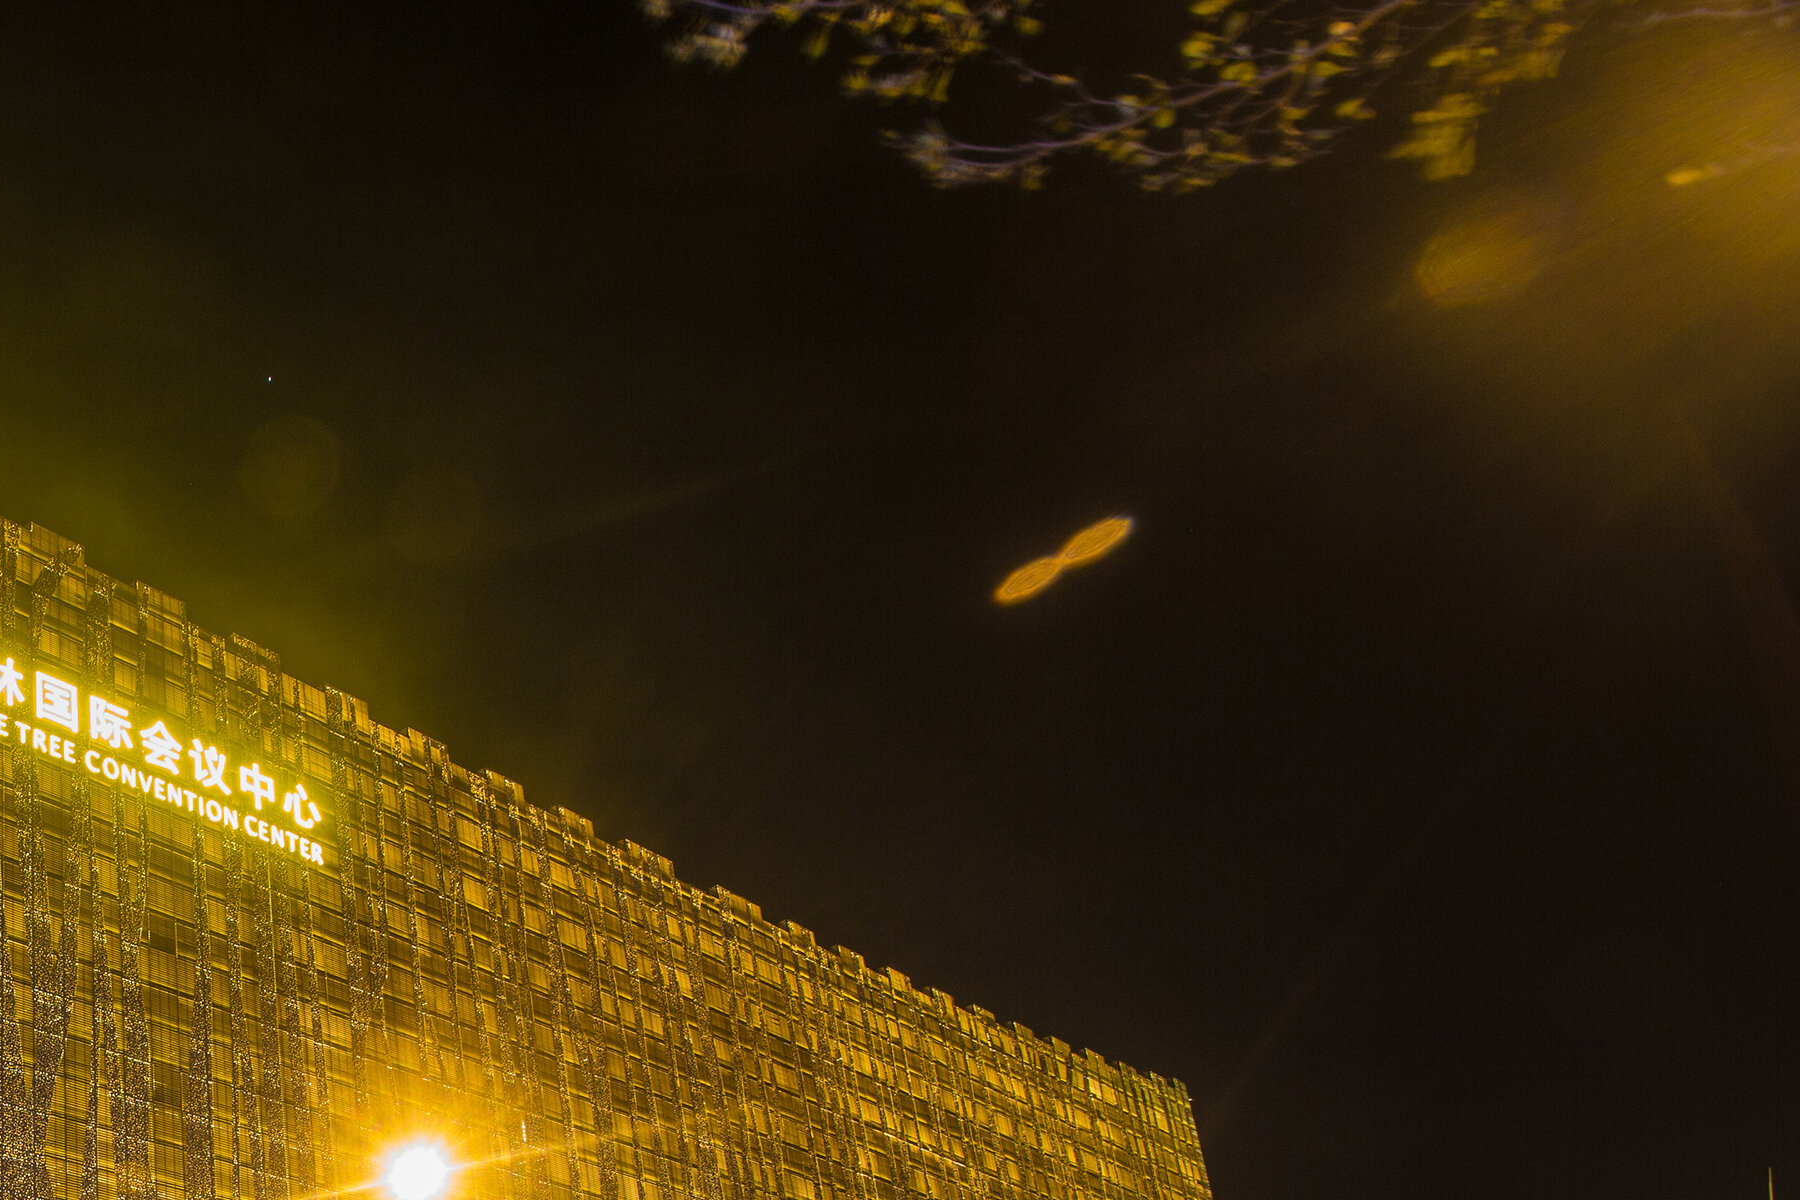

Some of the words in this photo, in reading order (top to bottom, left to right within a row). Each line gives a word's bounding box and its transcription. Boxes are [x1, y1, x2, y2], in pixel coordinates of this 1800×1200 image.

[14, 720, 76, 764] TREE
[84, 750, 239, 830] CONVENTION
[243, 815, 324, 866] CENTER
